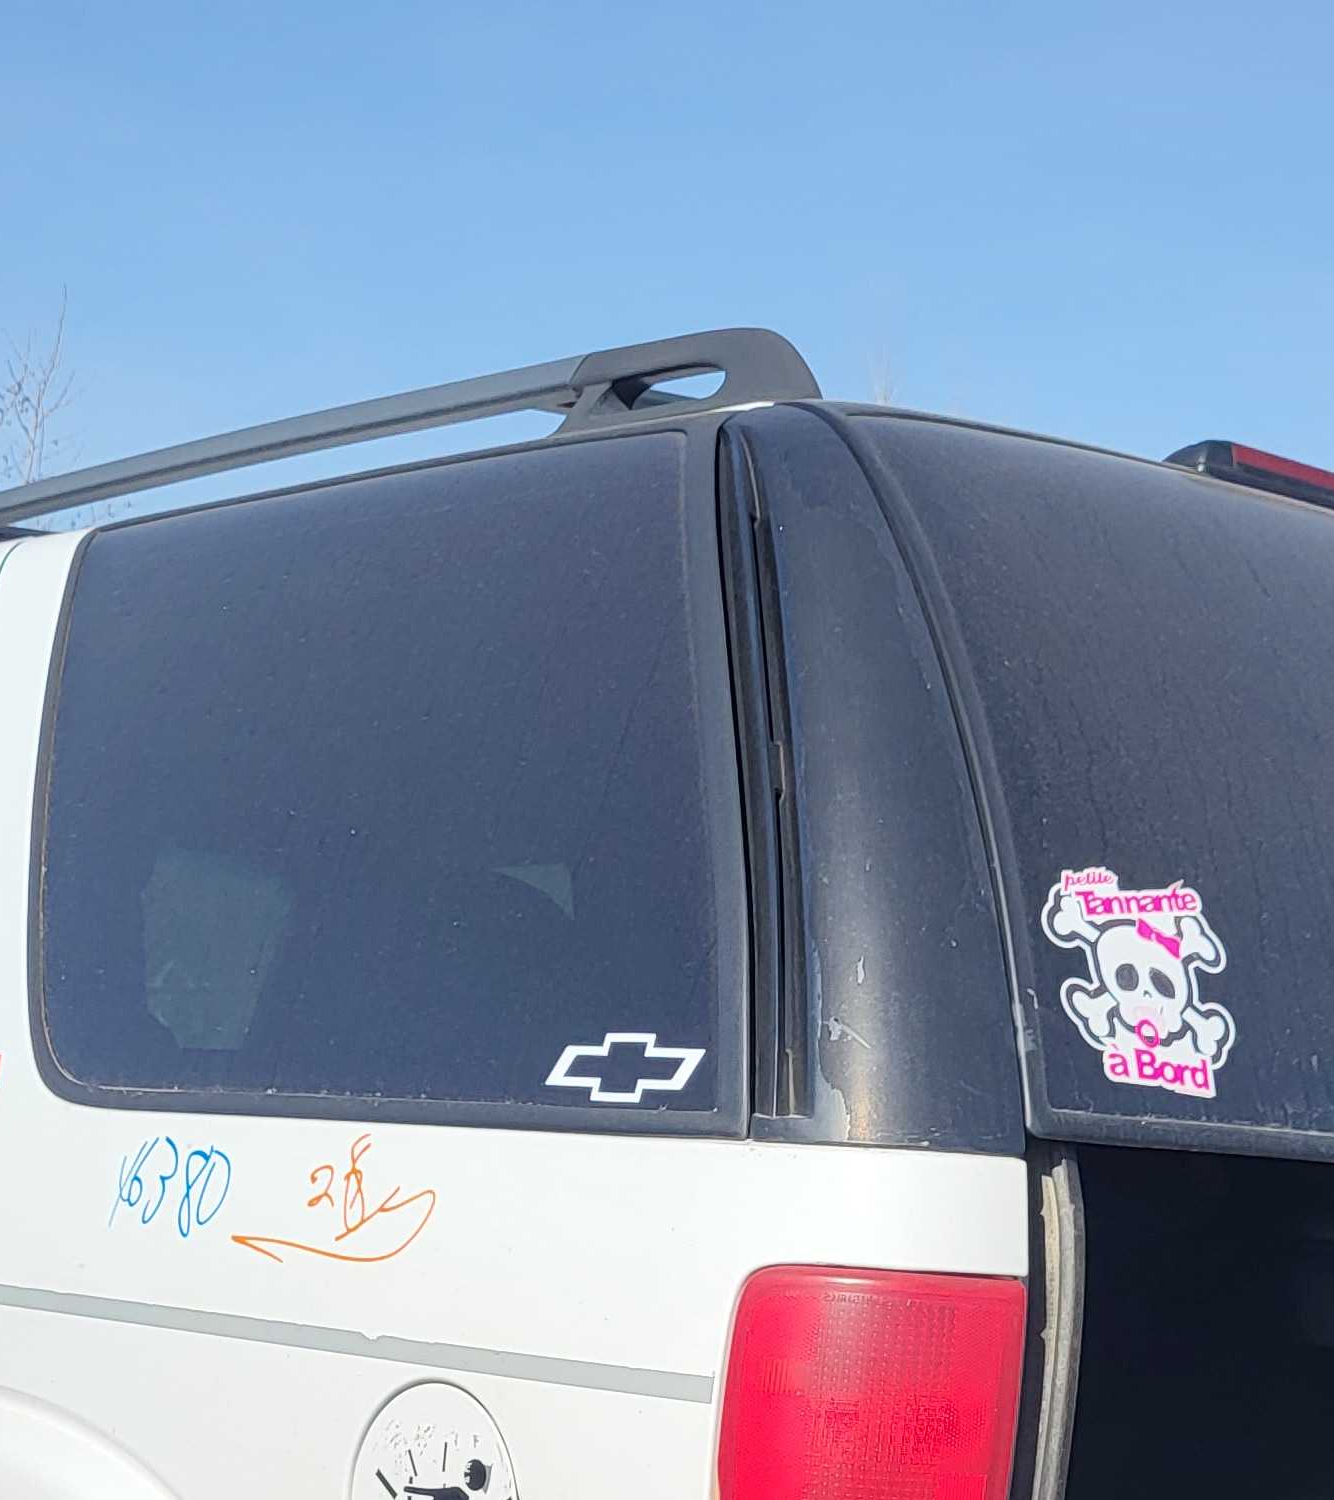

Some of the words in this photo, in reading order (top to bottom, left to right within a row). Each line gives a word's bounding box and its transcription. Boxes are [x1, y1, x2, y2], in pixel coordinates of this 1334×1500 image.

[1064, 870, 1115, 890] petite
[1074, 889, 1198, 916] Tannante
[1134, 1048, 1209, 1090] Bord
